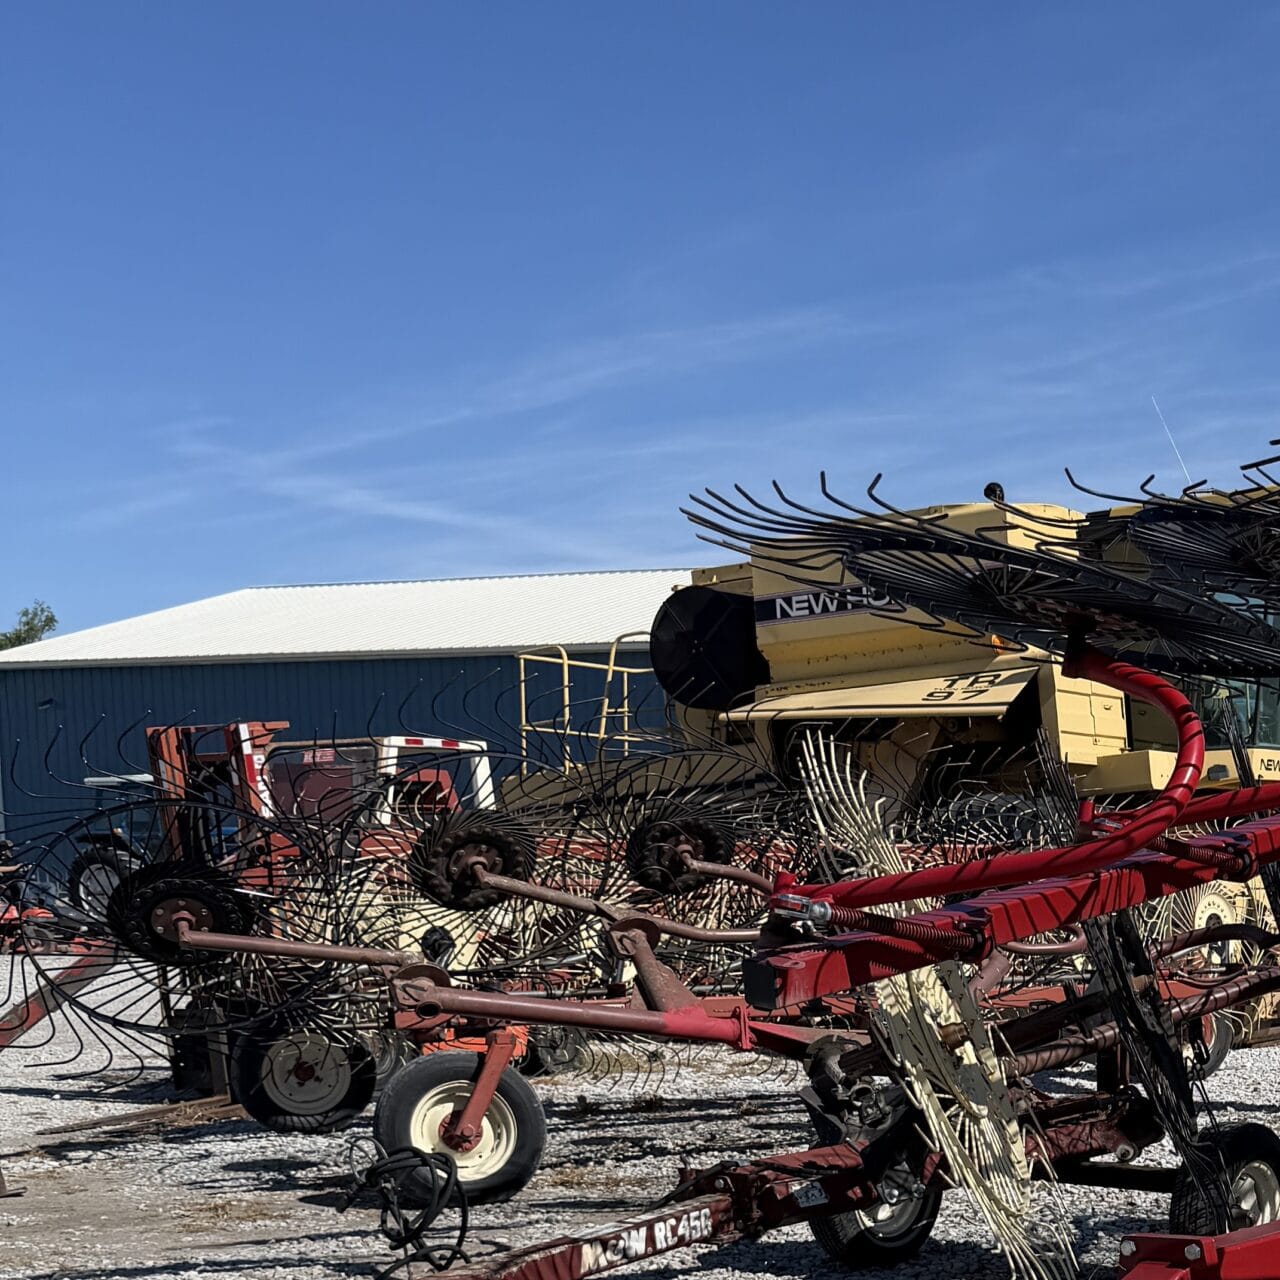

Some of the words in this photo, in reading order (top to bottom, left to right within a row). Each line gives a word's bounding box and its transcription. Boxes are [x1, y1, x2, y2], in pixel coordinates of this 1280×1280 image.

[775, 591, 840, 619] NEW
[943, 673, 1002, 689] TR
[921, 688, 990, 702] 97
